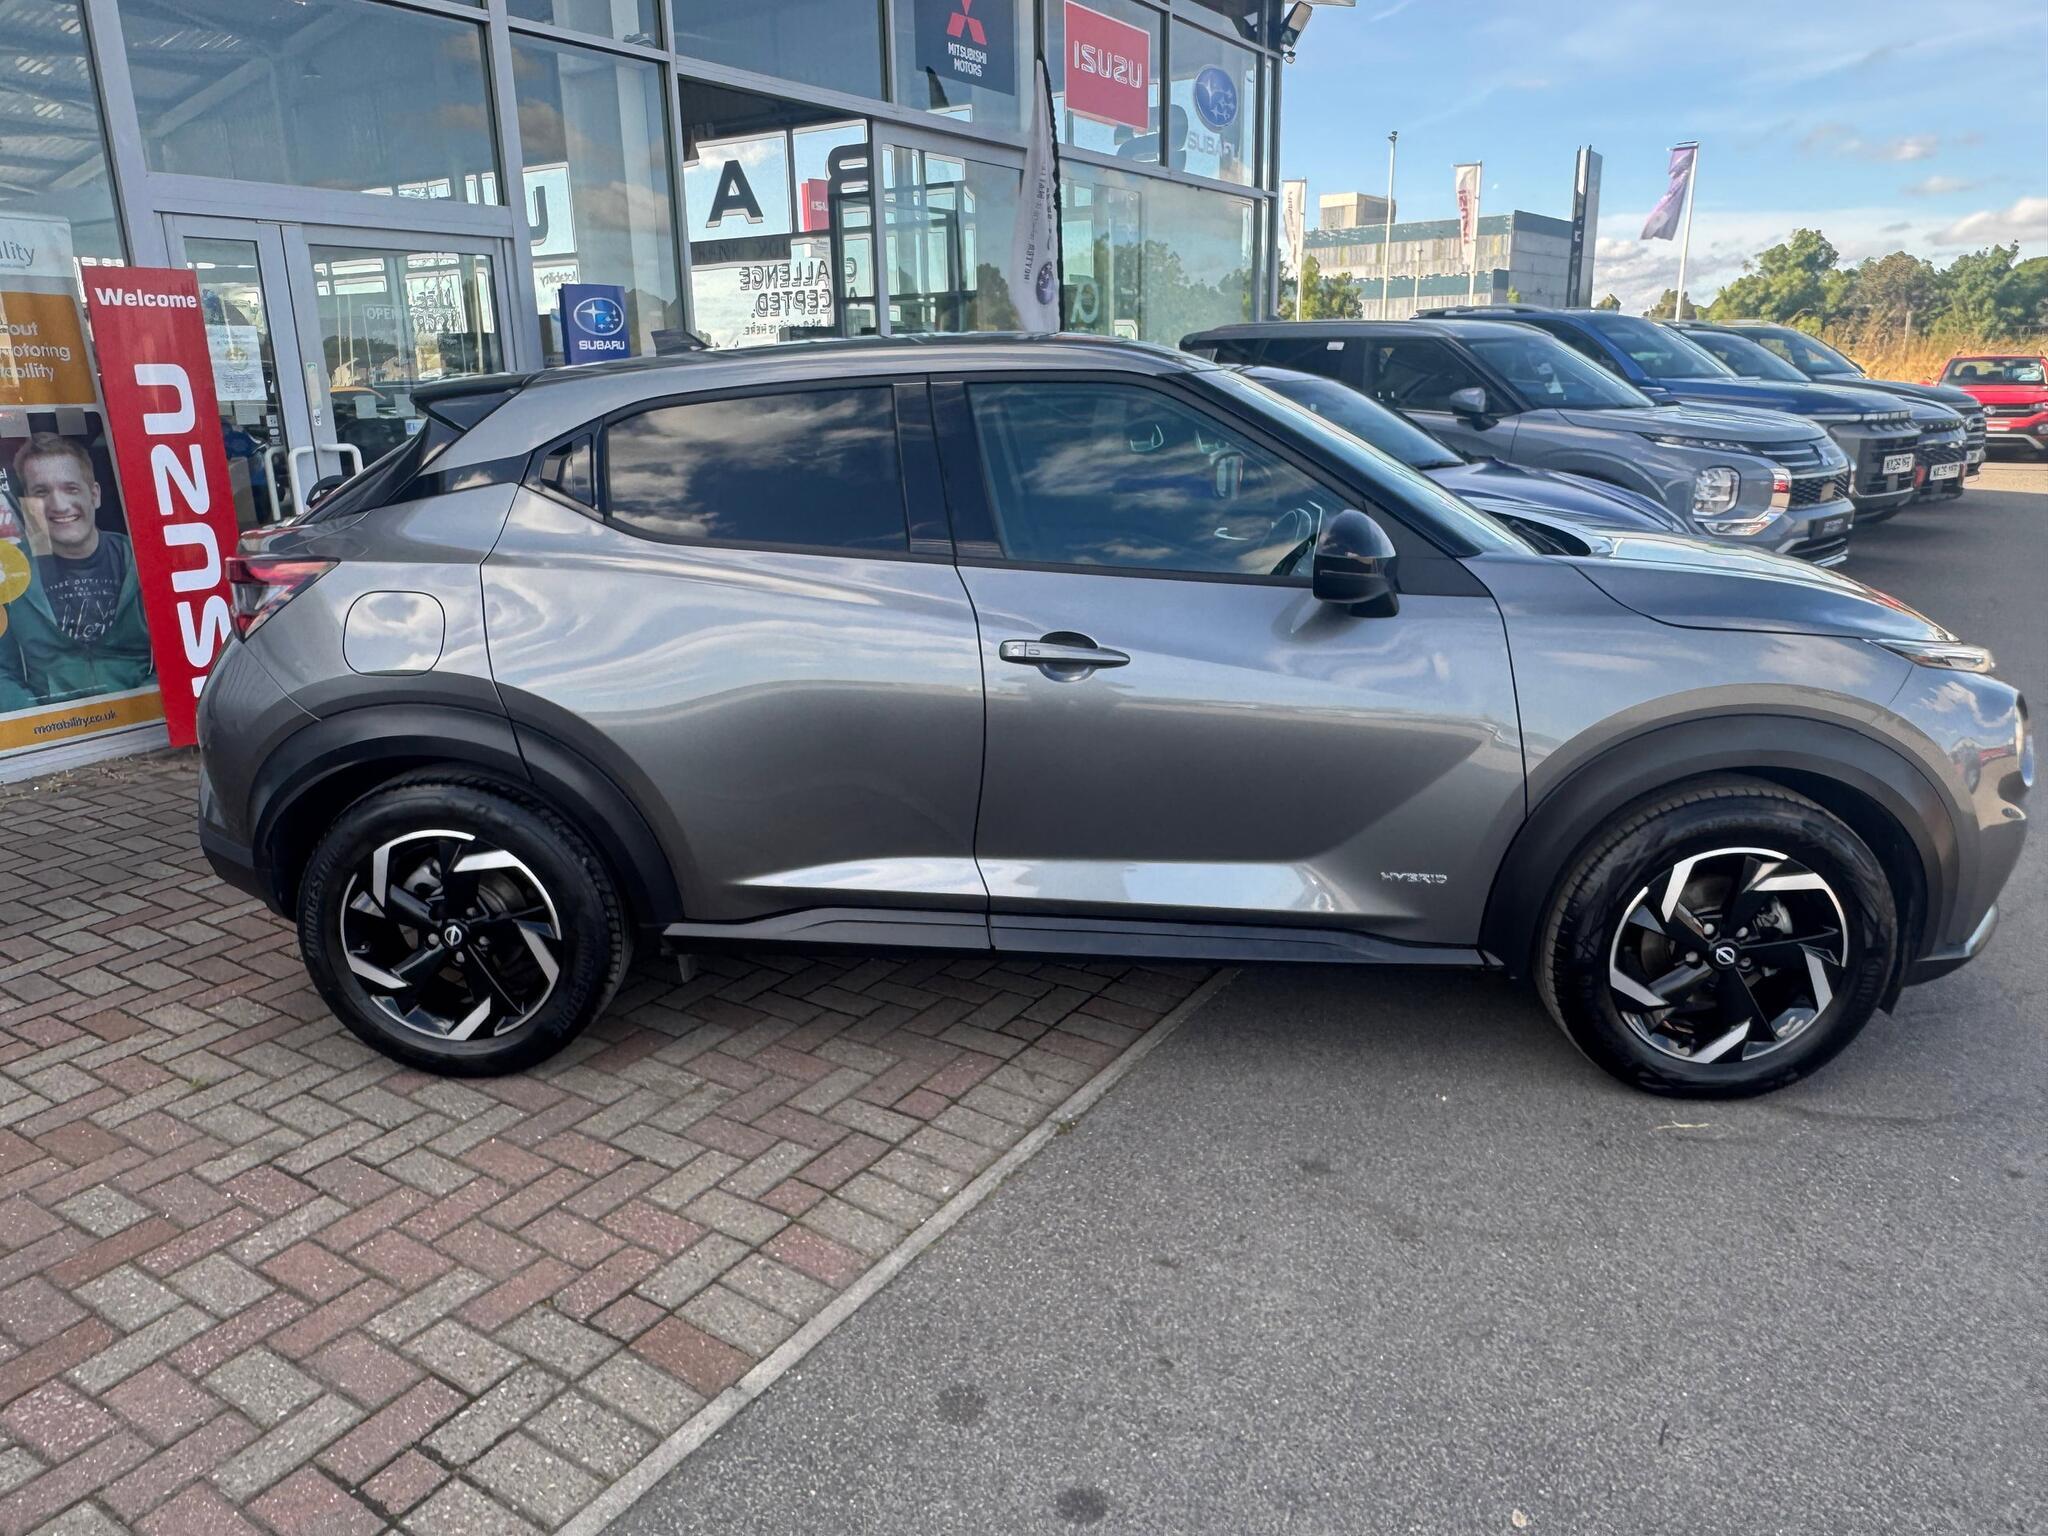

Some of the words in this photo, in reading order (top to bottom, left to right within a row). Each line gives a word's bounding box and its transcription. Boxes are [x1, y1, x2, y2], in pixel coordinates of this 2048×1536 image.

[948, 42, 987, 65] MITSUBISHI
[1073, 40, 1142, 88] ISUZU
[954, 58, 982, 77] MOTORS
[95, 287, 197, 308] Welcome
[578, 340, 625, 351] SUBARU
[133, 363, 232, 699] SUZU
[1380, 871, 1447, 884] HYBRID
